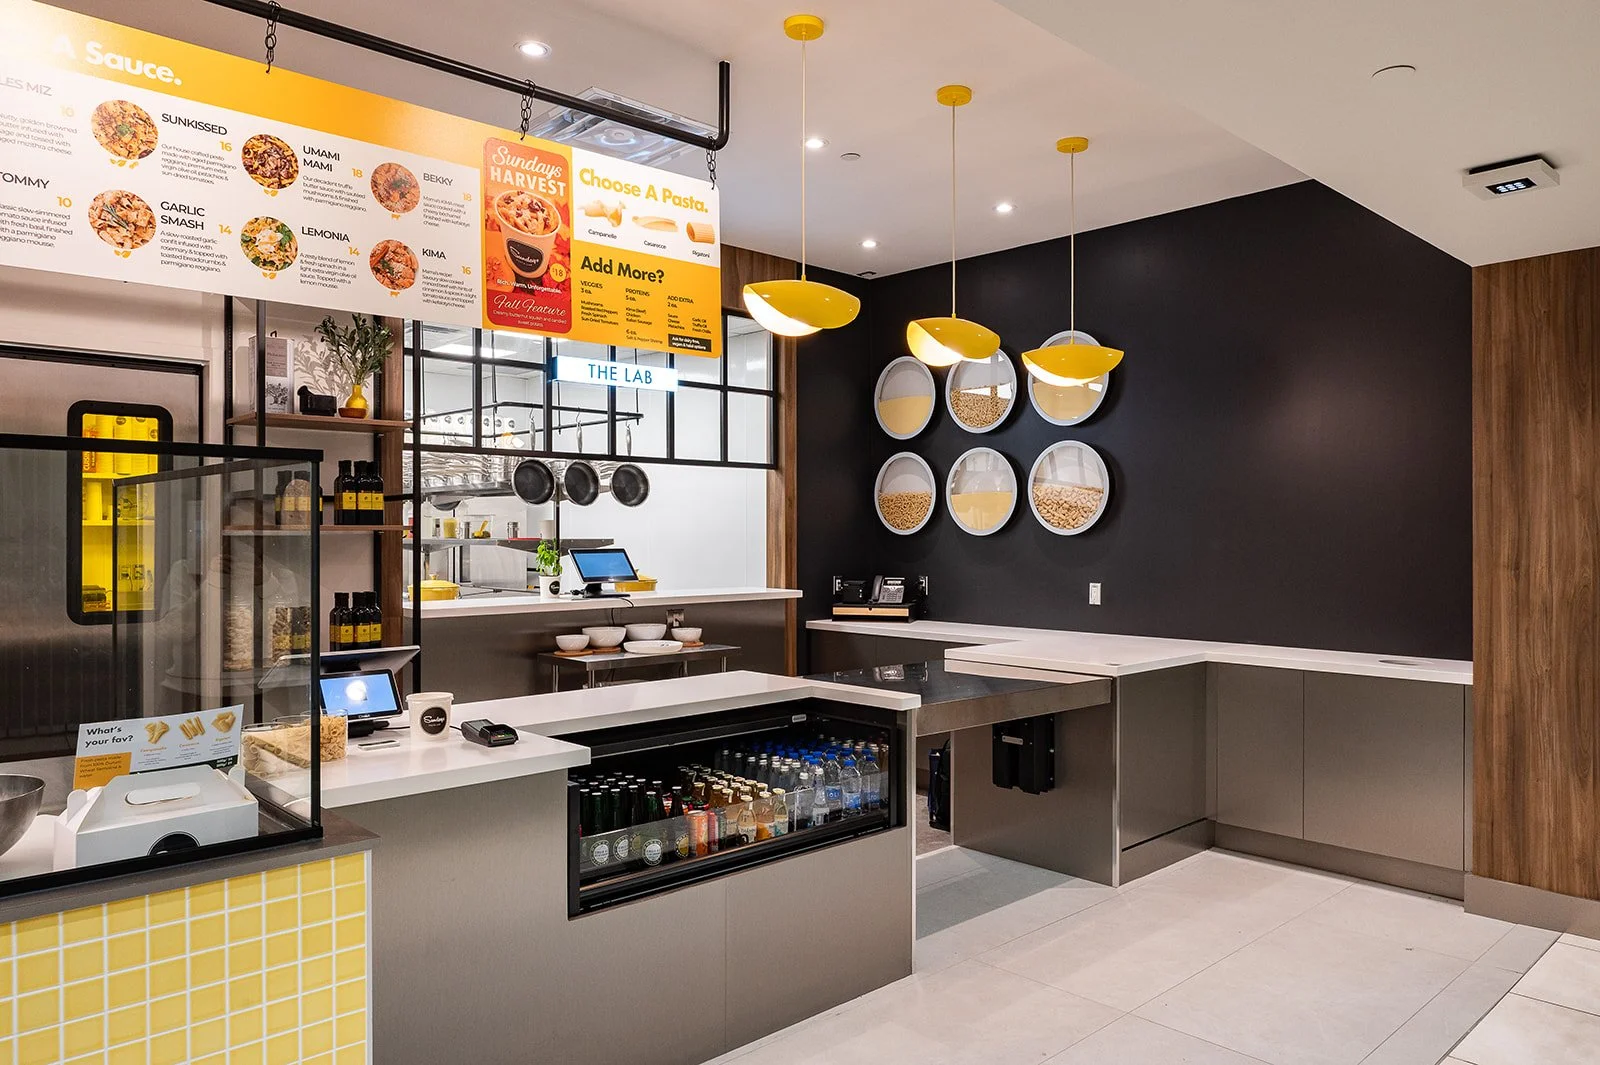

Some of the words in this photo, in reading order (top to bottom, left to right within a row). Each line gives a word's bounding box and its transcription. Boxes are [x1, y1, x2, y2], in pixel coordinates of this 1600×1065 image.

[52, 34, 76, 60] A
[85, 41, 182, 86] Sauce.
[26, 82, 52, 96] MIZ
[161, 113, 228, 136] SUNKISSED
[219, 140, 233, 152] 16
[303, 145, 340, 161] UMAMI
[303, 158, 333, 172] MAMI
[492, 145, 563, 179] Sundays
[352, 167, 363, 178] 18
[423, 172, 453, 186] BEKKY
[490, 166, 566, 197] HARVEST
[579, 167, 641, 197] Choose
[645, 184, 658, 201] A
[662, 187, 708, 213] Pasta.
[57, 196, 72, 208] 10
[160, 201, 205, 217] GARLIC
[160, 214, 204, 230] SMASH
[218, 224, 232, 235] 14
[301, 226, 350, 243] LEMONIA
[588, 229, 617, 240] Campanelle
[348, 246, 360, 256] 14
[422, 248, 446, 260] KIMA
[461, 265, 471, 275] 16
[580, 256, 613, 275] Add
[617, 262, 664, 283] More?
[580, 280, 603, 289] VEGGIES
[625, 288, 650, 297] PROTEINS
[493, 294, 521, 309] Fall
[522, 298, 566, 316] Feature
[588, 363, 617, 381] THE
[625, 367, 652, 384] LAB
[86, 726, 122, 735] What's
[85, 739, 109, 748] your
[112, 735, 133, 743] fav?
